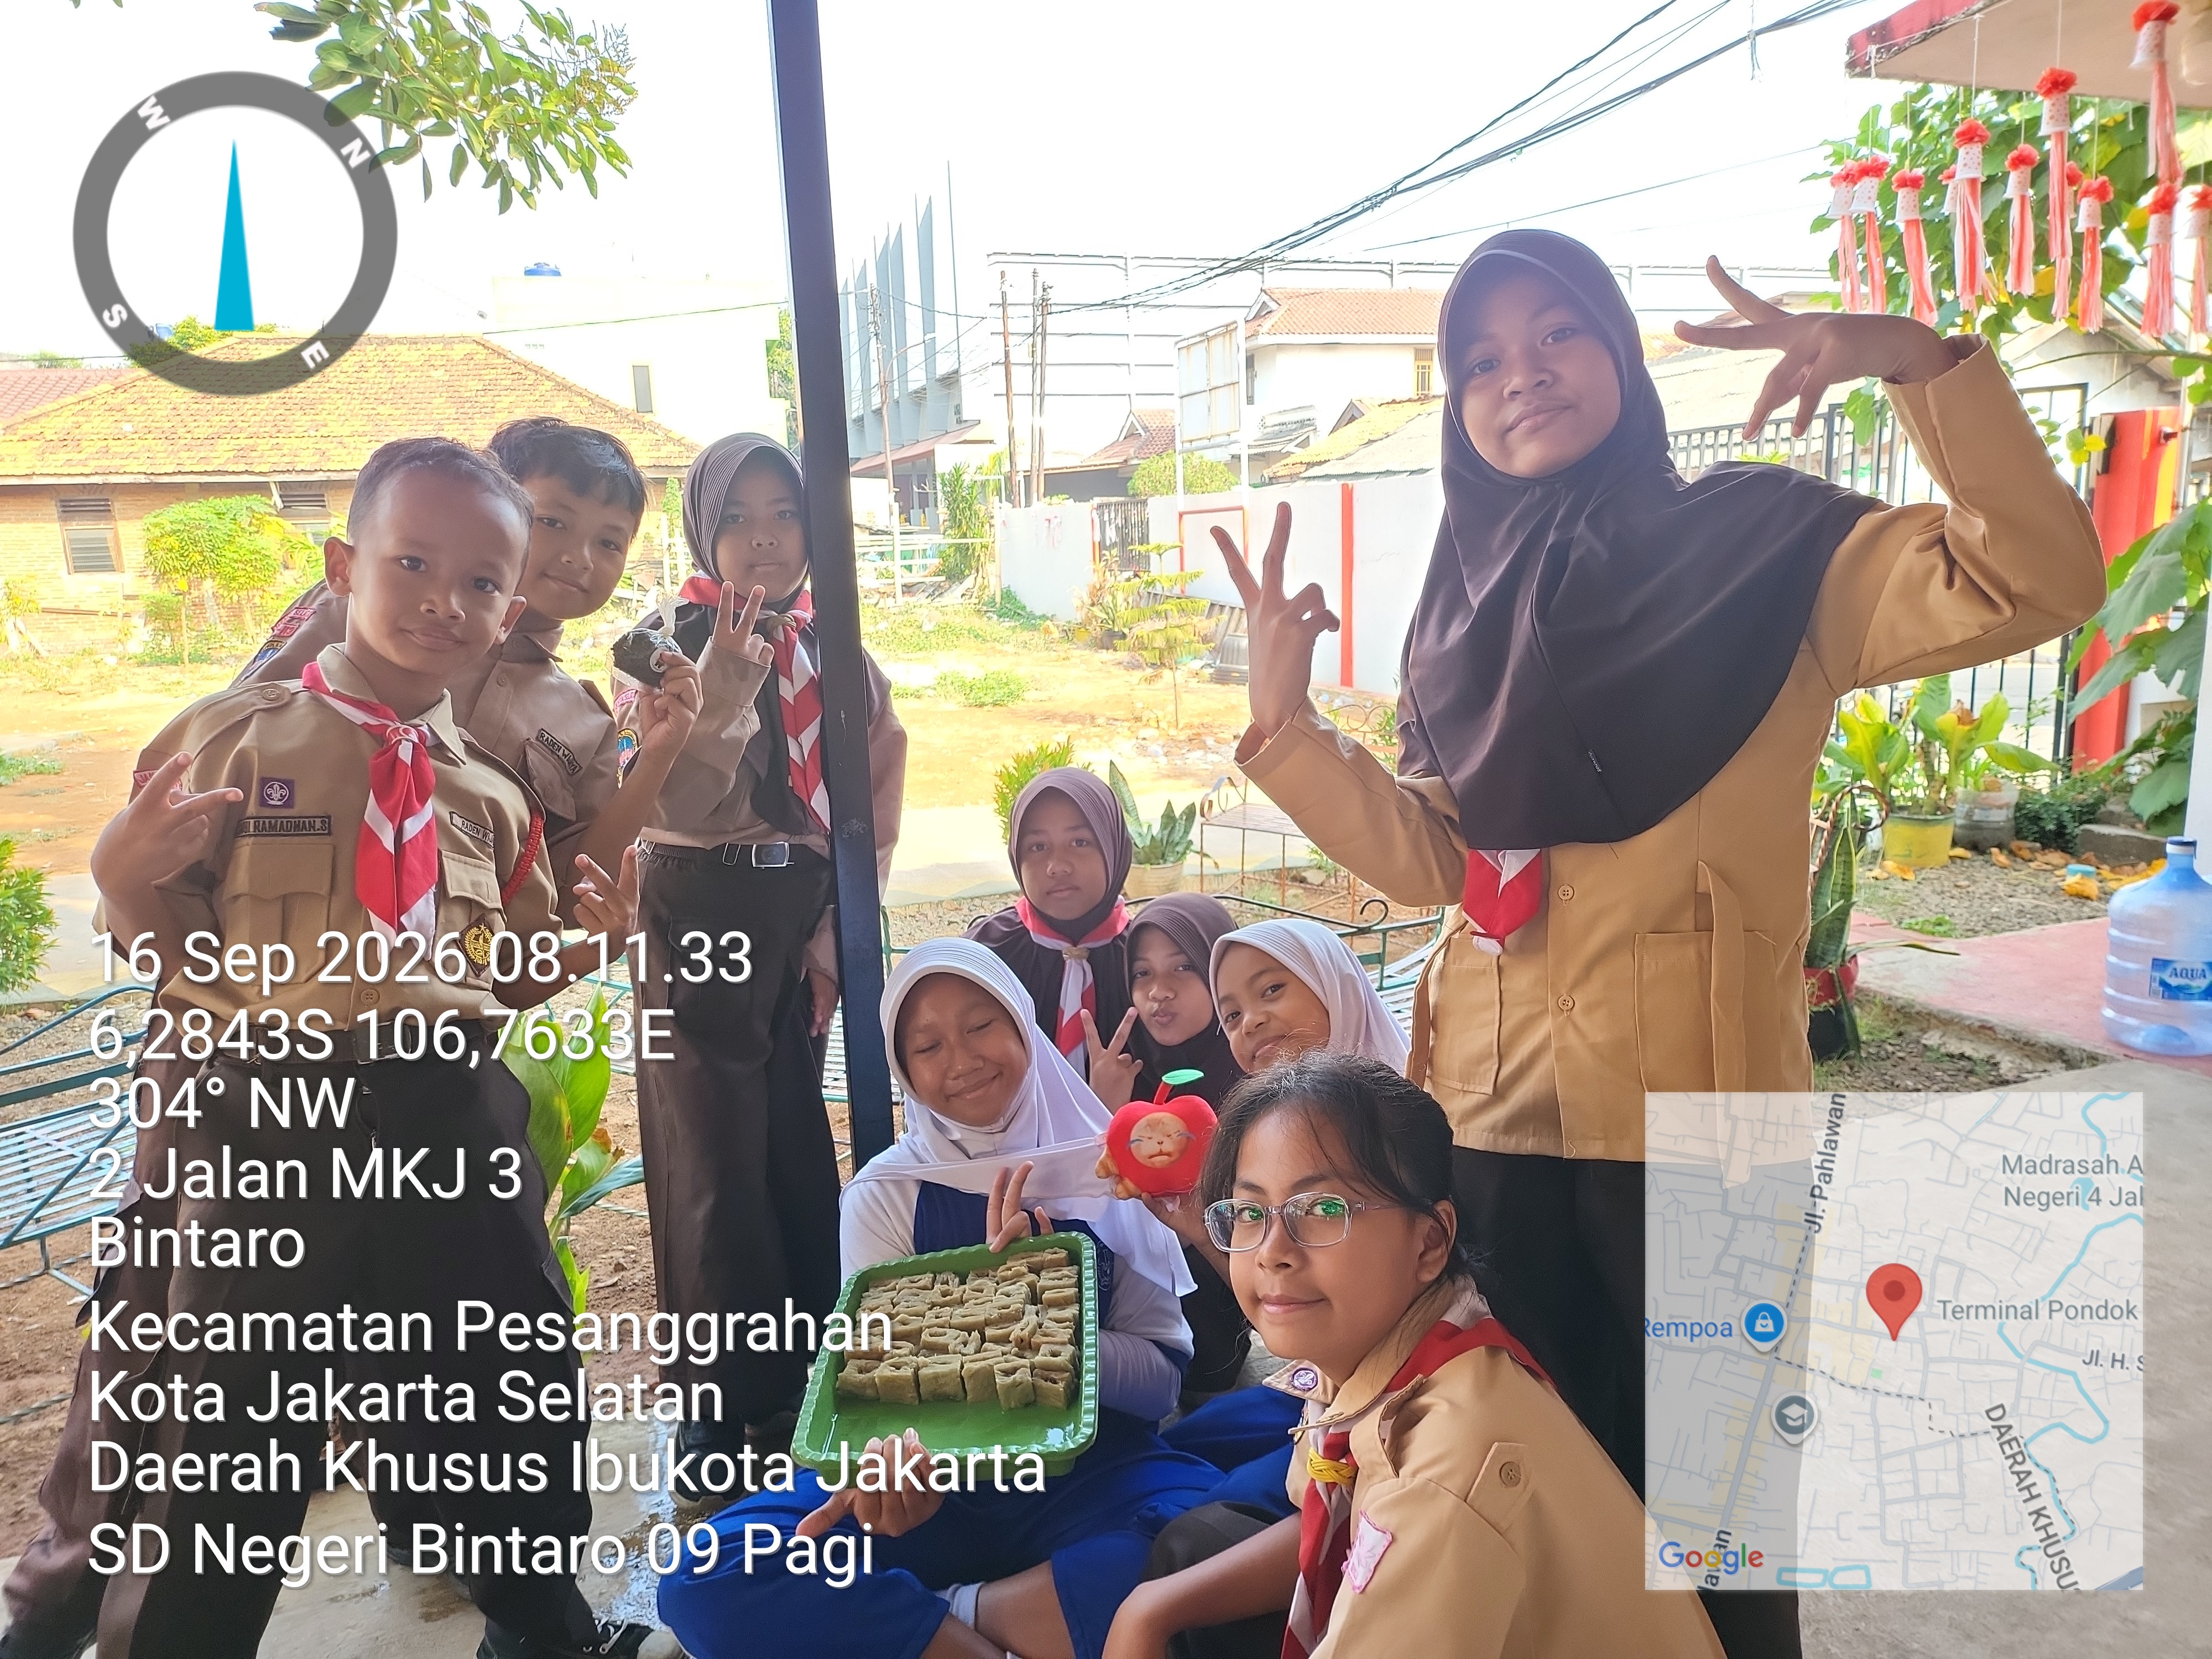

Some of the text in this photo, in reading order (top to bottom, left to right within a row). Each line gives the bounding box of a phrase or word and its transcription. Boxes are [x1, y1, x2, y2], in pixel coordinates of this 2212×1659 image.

[539, 732, 562, 753] RADEN
[461, 820, 480, 836] RADEN
[2168, 967, 2206, 981] AQUA
